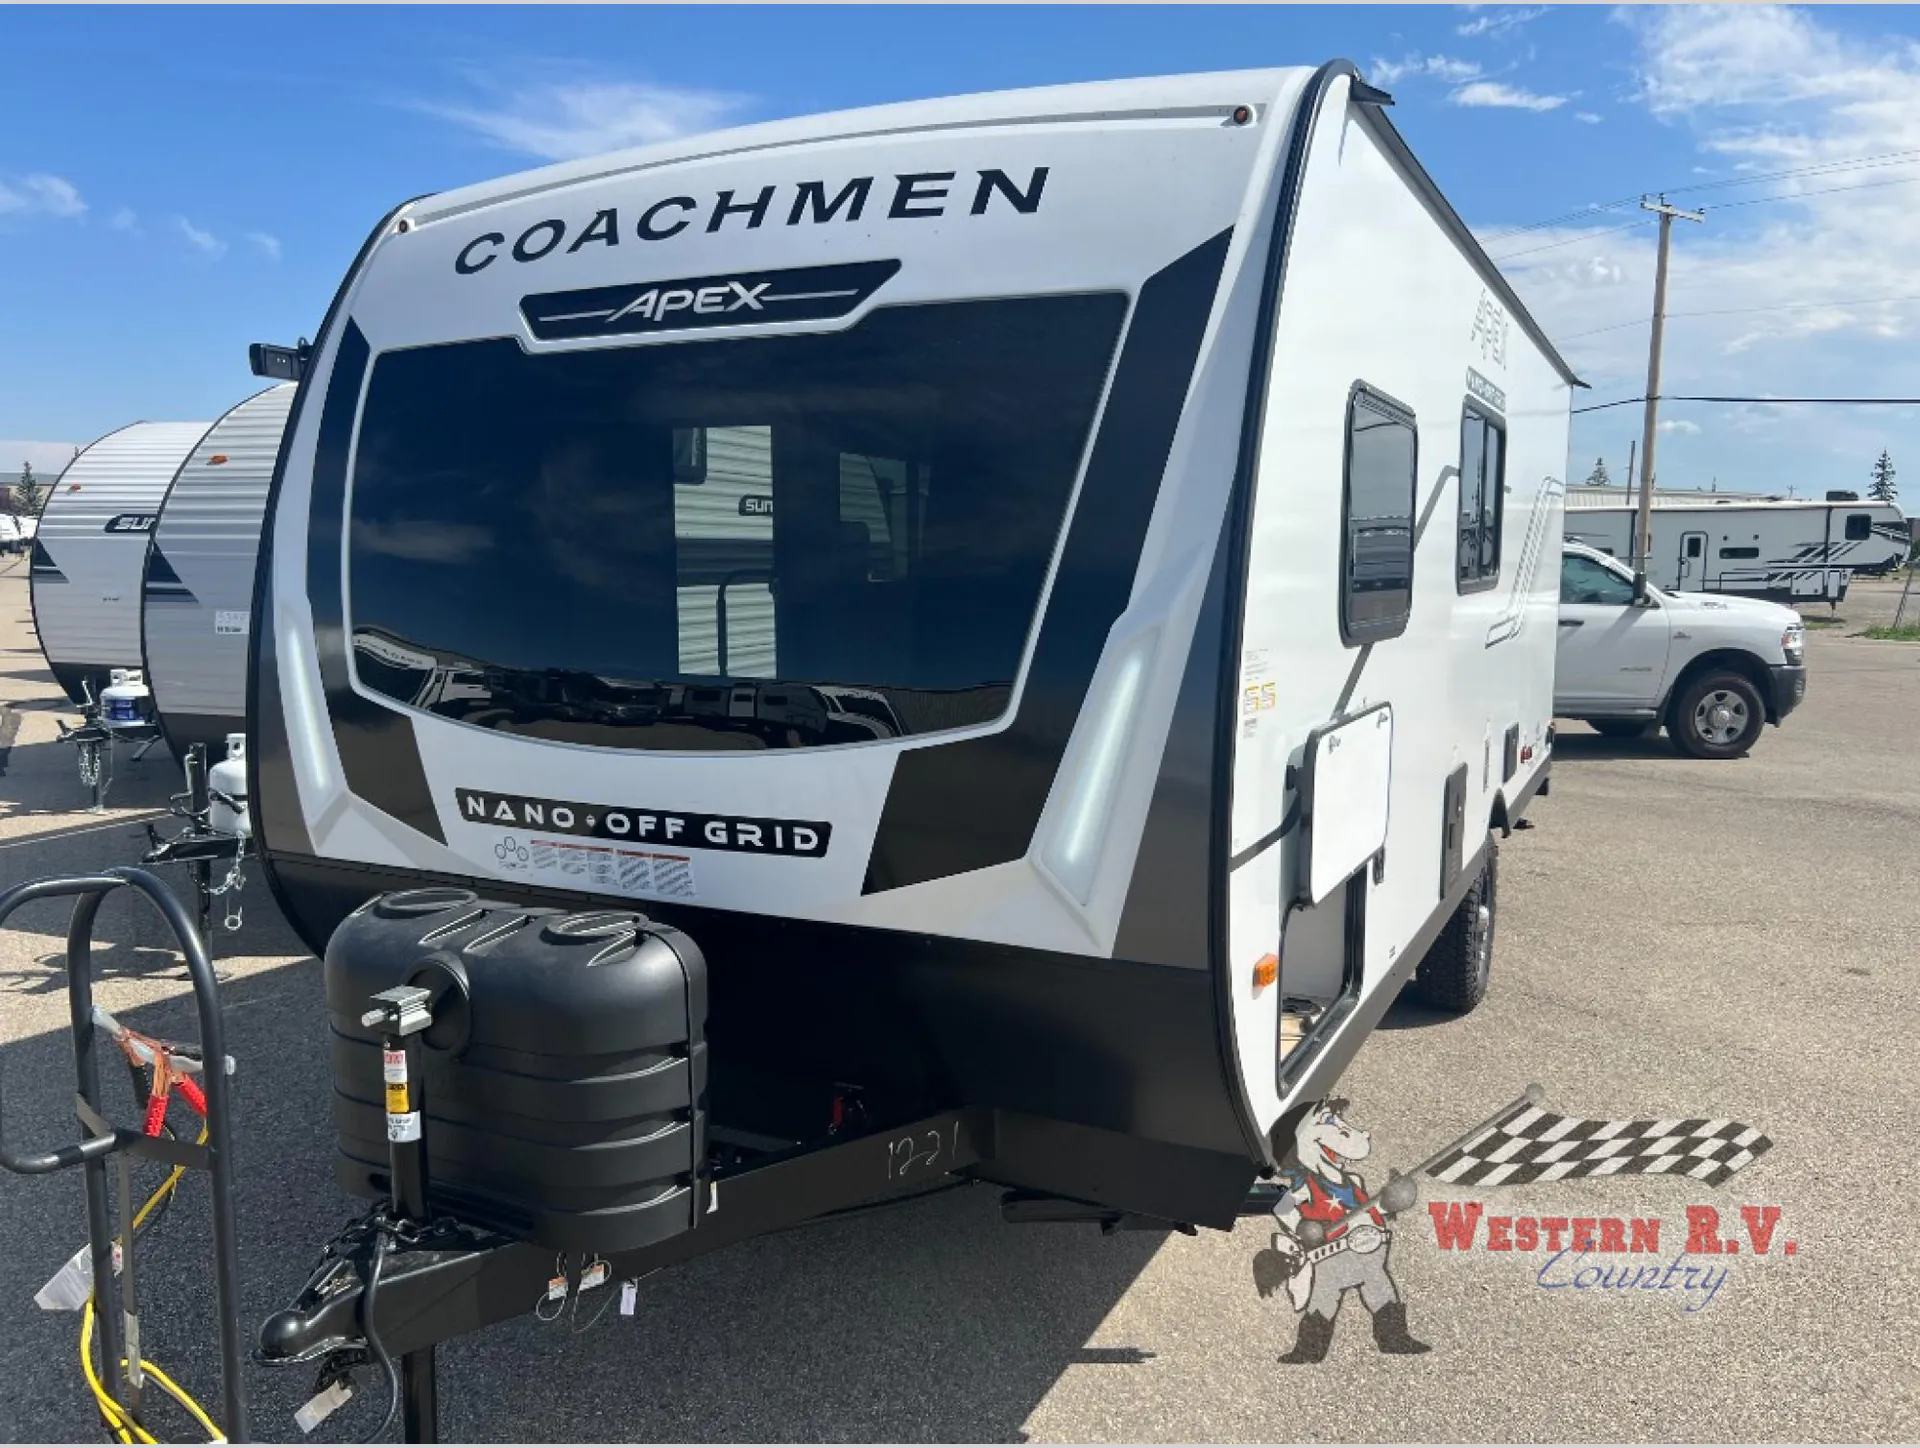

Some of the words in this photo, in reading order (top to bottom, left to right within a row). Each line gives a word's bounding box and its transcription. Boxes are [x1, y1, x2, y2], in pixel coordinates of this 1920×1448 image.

[454, 166, 1050, 275] COACHMEN
[604, 280, 772, 322] APEX
[466, 794, 576, 829] NANO
[604, 812, 686, 840] OFF
[703, 821, 820, 852] GRID
